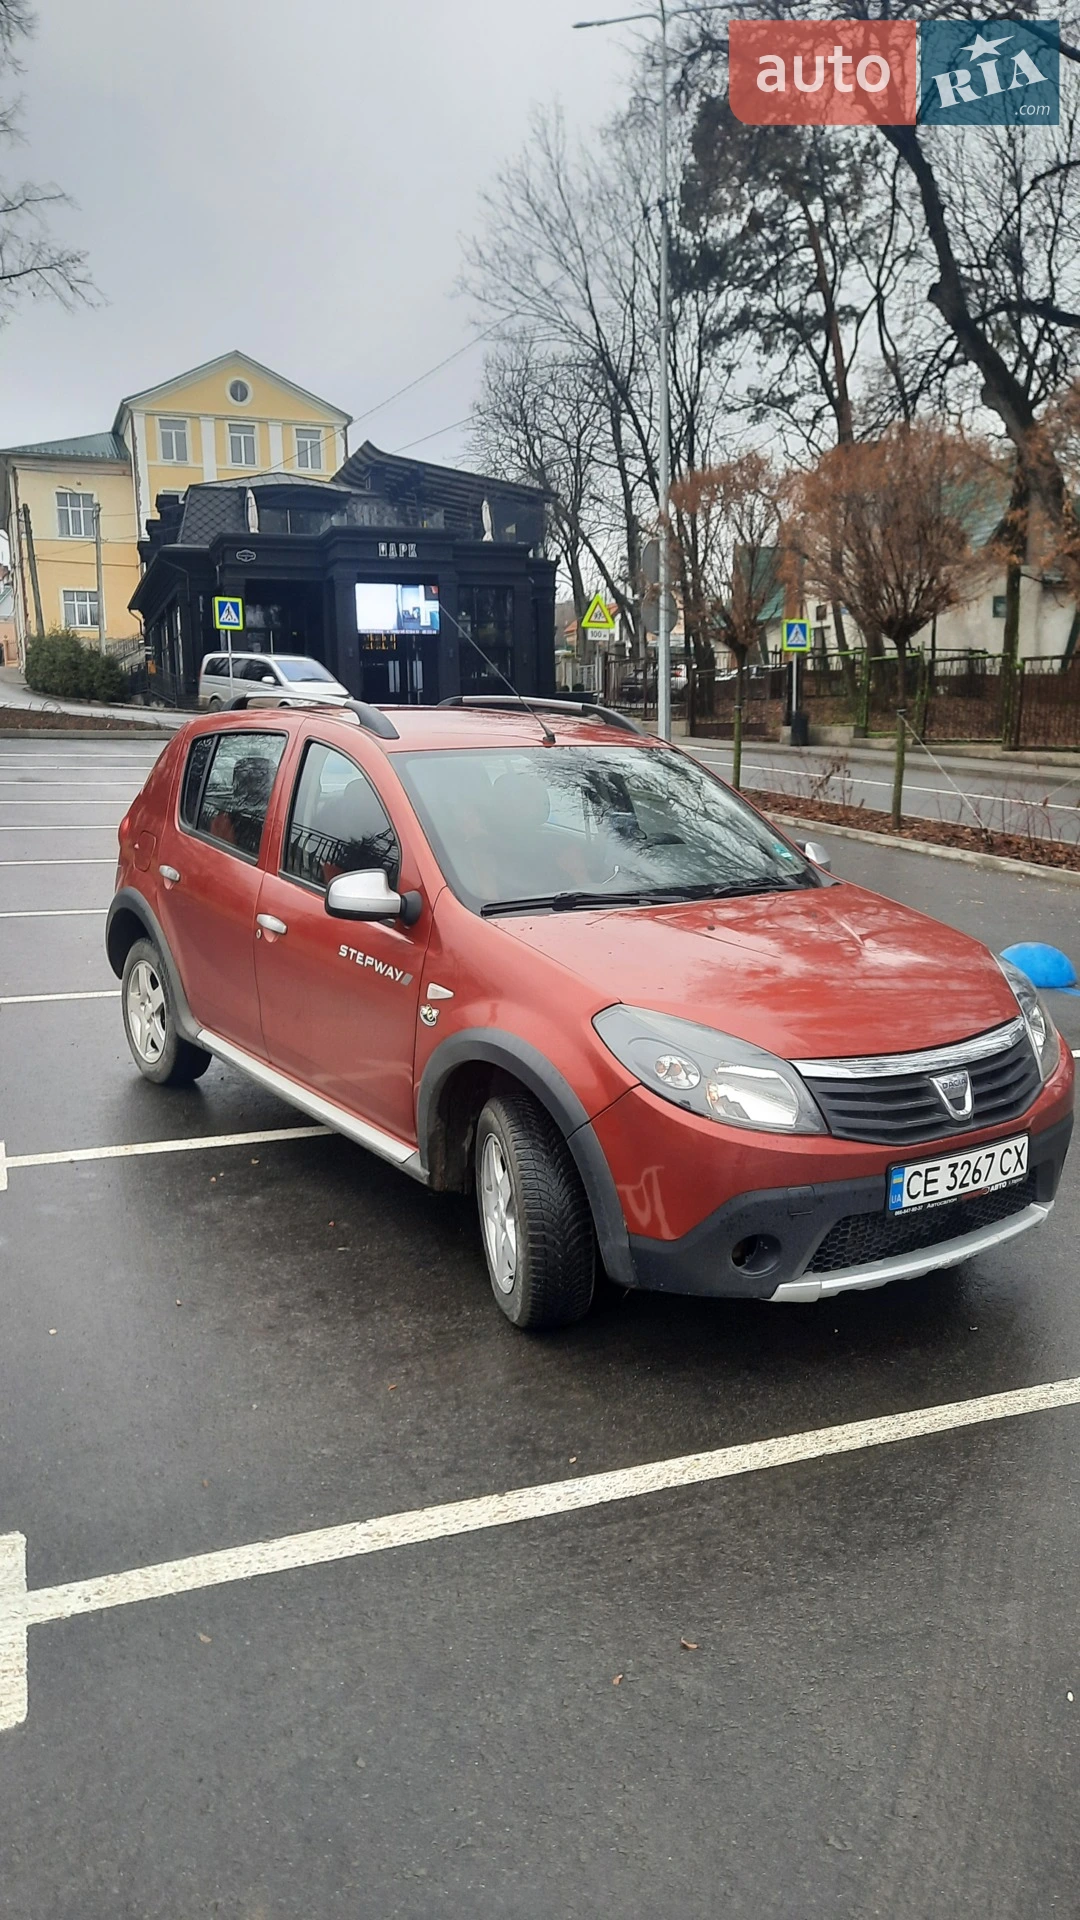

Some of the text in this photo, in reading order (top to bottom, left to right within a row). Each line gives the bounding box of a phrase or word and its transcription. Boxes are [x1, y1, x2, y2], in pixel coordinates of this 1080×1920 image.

[378, 542, 418, 558] ПАРК
[590, 630, 602, 638] 100
[338, 944, 404, 981] STEPWAY
[942, 1078, 967, 1089] DACIA
[906, 1142, 1026, 1200] CE 3267 CX
[891, 1193, 902, 1204] UA
